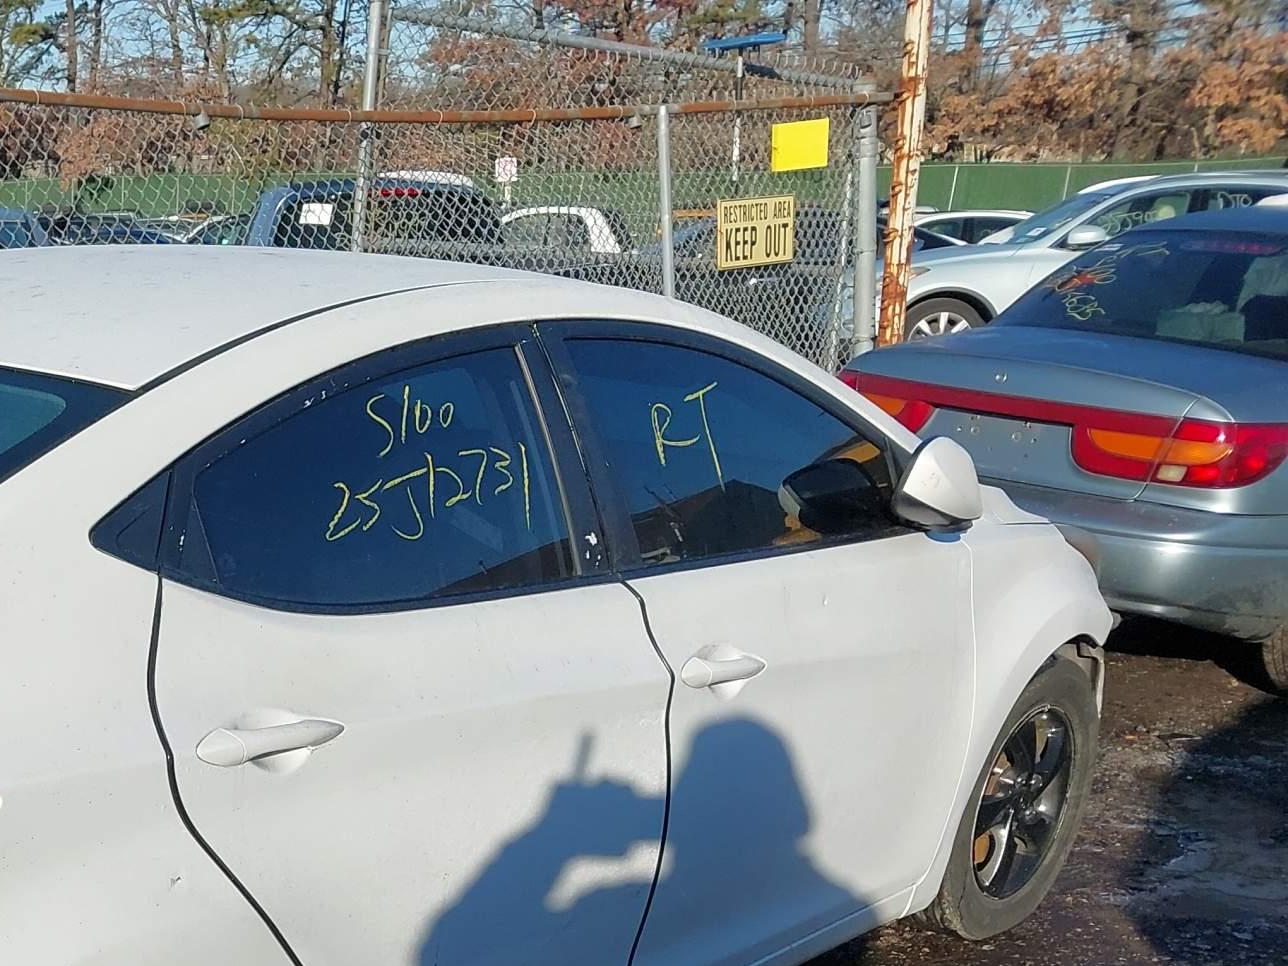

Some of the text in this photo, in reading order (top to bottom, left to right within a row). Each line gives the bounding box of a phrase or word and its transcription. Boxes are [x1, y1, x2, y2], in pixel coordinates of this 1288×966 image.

[723, 200, 791, 224] RESTRICTED AREA
[725, 222, 789, 262] KEEP OUT
[651, 381, 726, 494] RT
